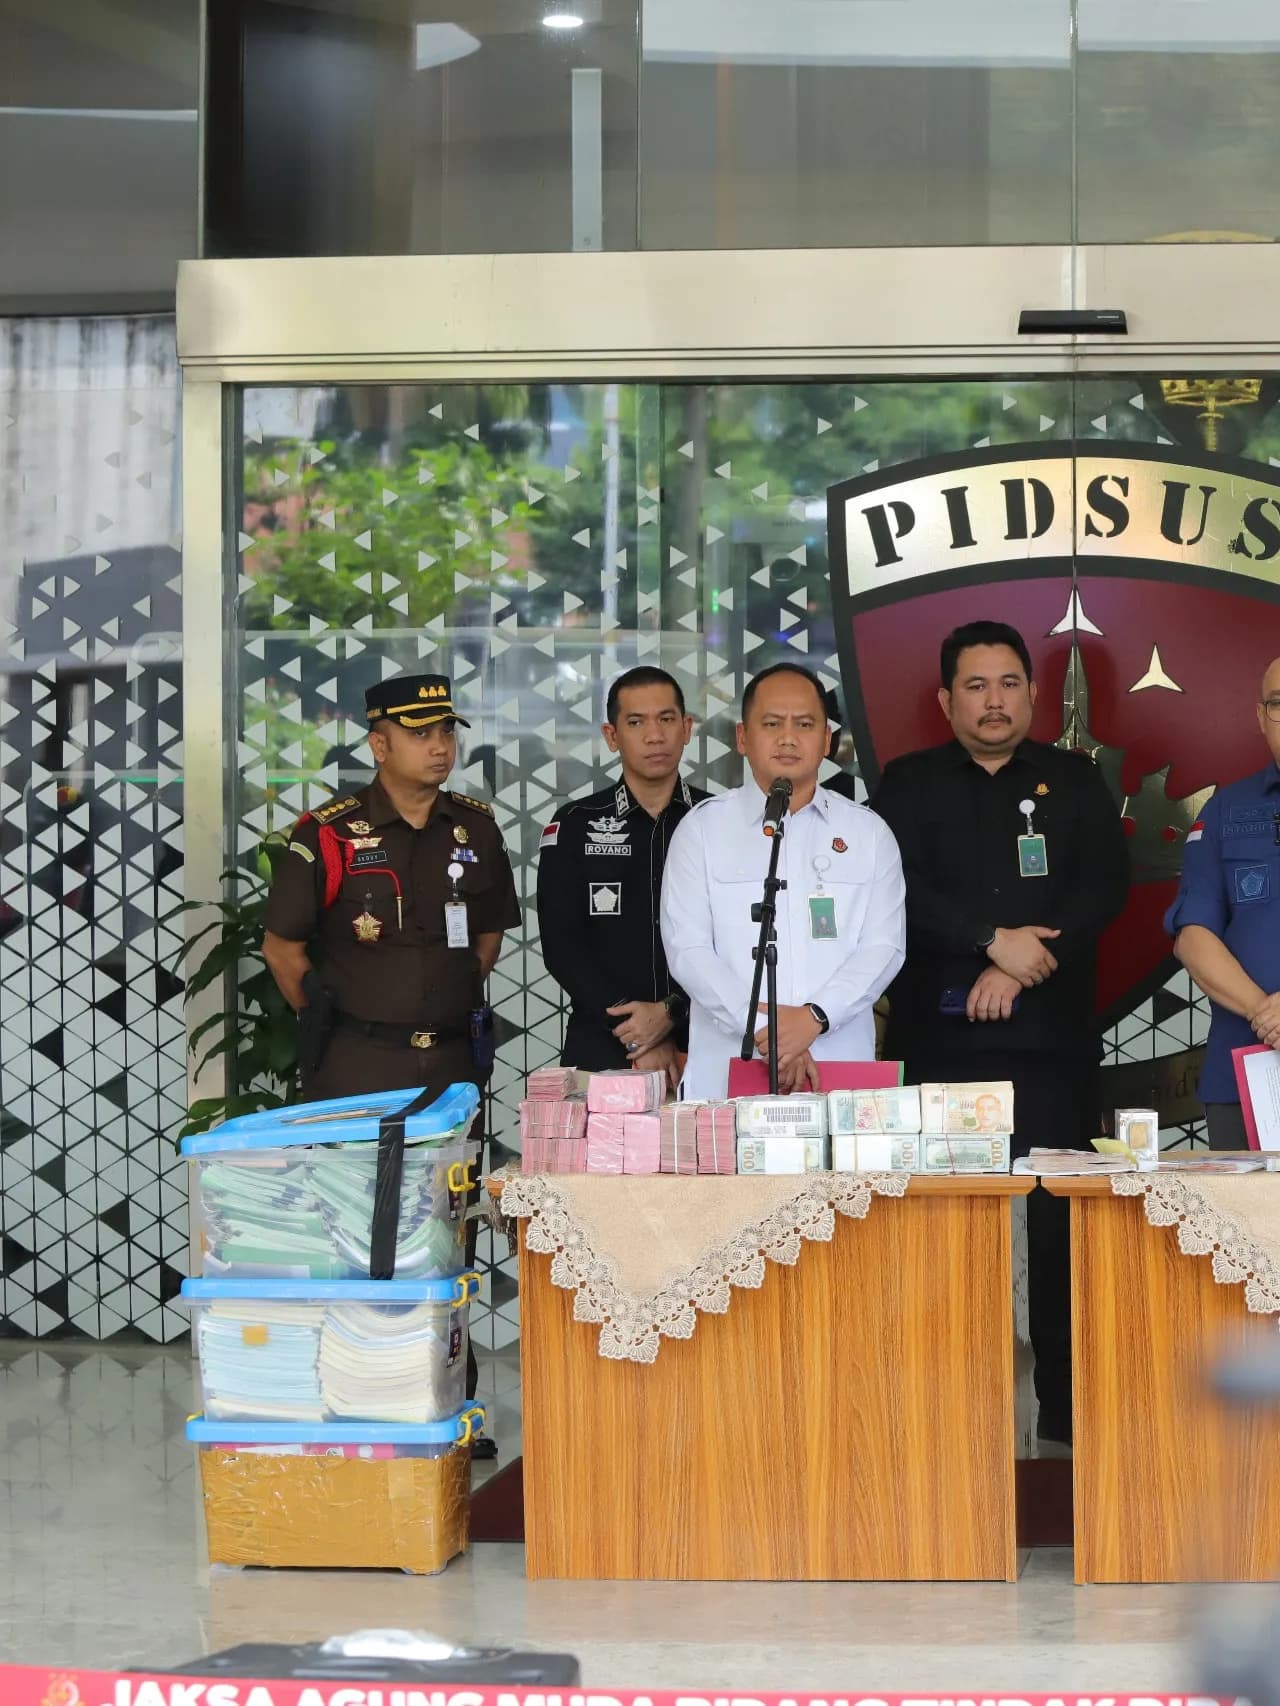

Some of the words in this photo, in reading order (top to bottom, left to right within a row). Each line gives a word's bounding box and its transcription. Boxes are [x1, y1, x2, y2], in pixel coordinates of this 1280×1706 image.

[587, 845, 629, 855] ROVANO
[902, 1141, 914, 1168] 100
[991, 1140, 1004, 1166] 100
[102, 1679, 276, 1706] JAKSA
